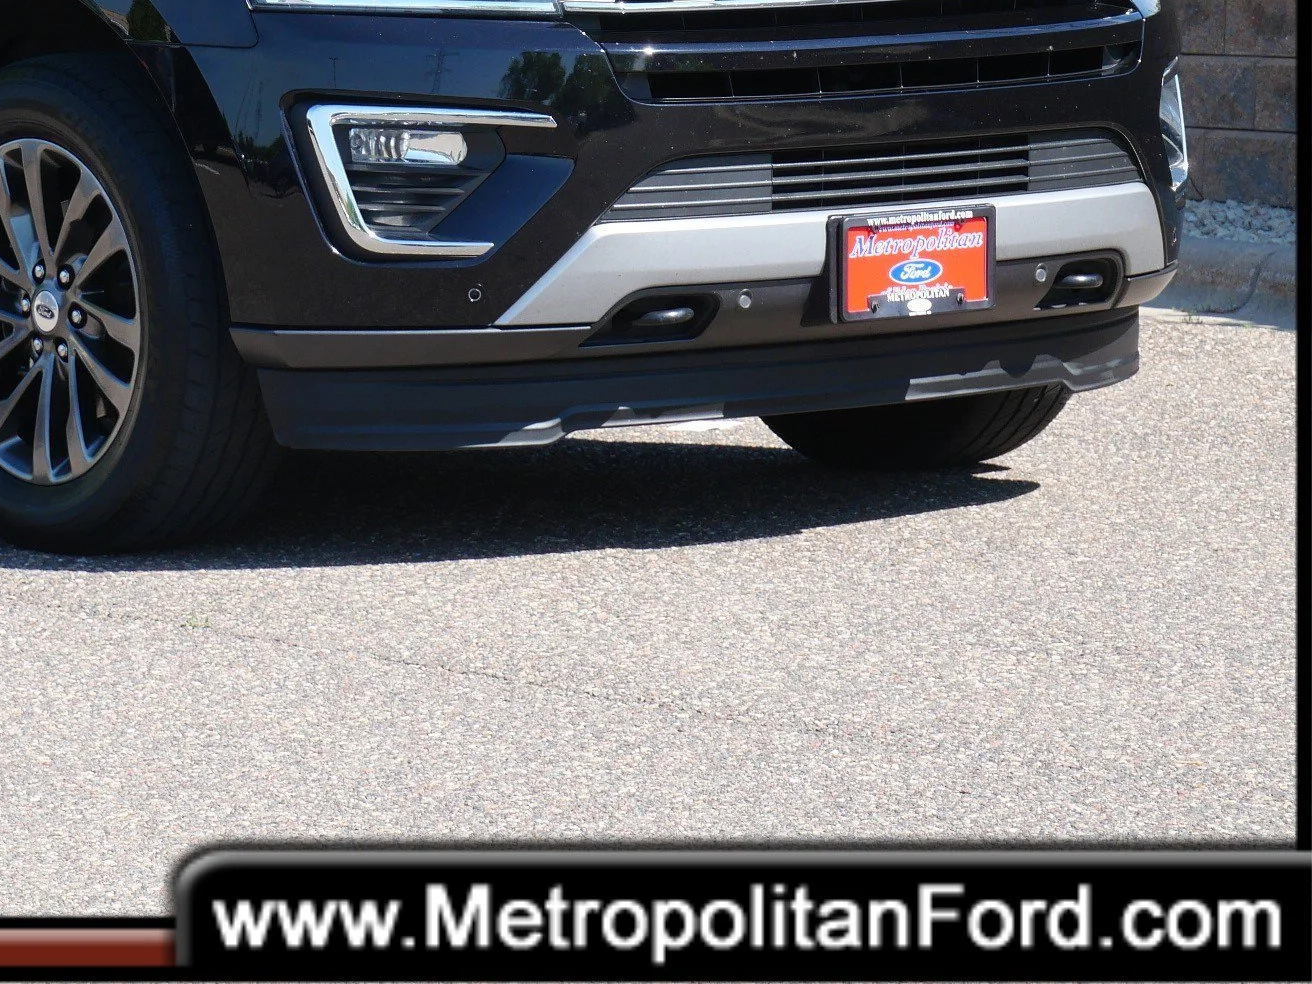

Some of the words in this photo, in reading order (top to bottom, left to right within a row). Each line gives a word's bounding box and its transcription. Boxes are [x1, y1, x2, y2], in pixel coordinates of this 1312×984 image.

[867, 209, 974, 226] www.metropolitanford.com
[848, 227, 984, 259] Metropolitan
[900, 262, 933, 280] Ford
[887, 287, 950, 303] METROPOLITAN
